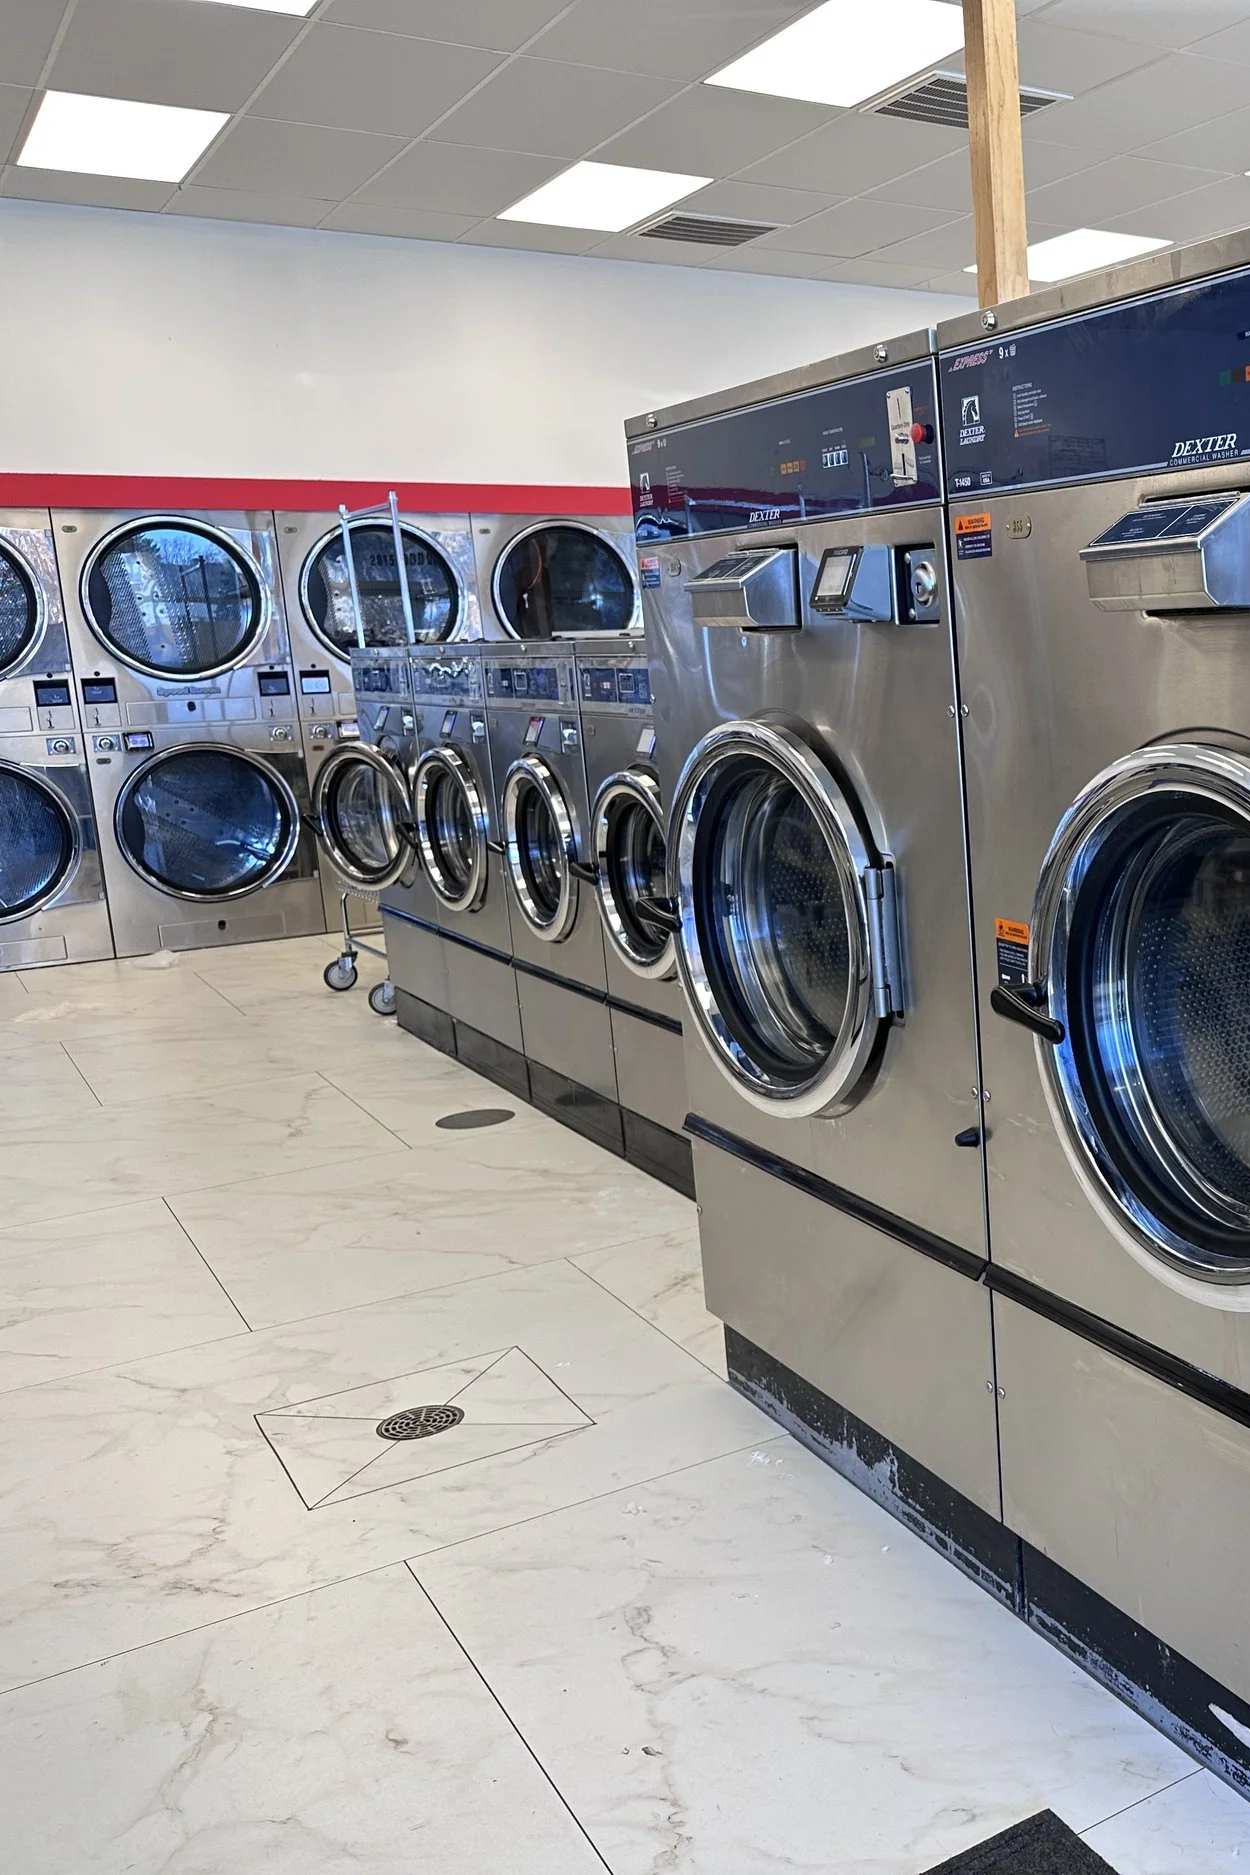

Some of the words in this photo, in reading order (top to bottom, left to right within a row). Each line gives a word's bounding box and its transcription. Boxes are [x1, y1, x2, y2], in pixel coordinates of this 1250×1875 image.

[998, 347, 1004, 359] 9
[953, 351, 988, 371] EXPRESS
[959, 426, 984, 438] DEXTER
[960, 434, 986, 445] LAUNDRY
[1172, 433, 1236, 458] DEXTER
[1169, 455, 1209, 466] COMMERCIAL
[1212, 449, 1238, 459] WASHER
[749, 509, 780, 522] DEXTER
